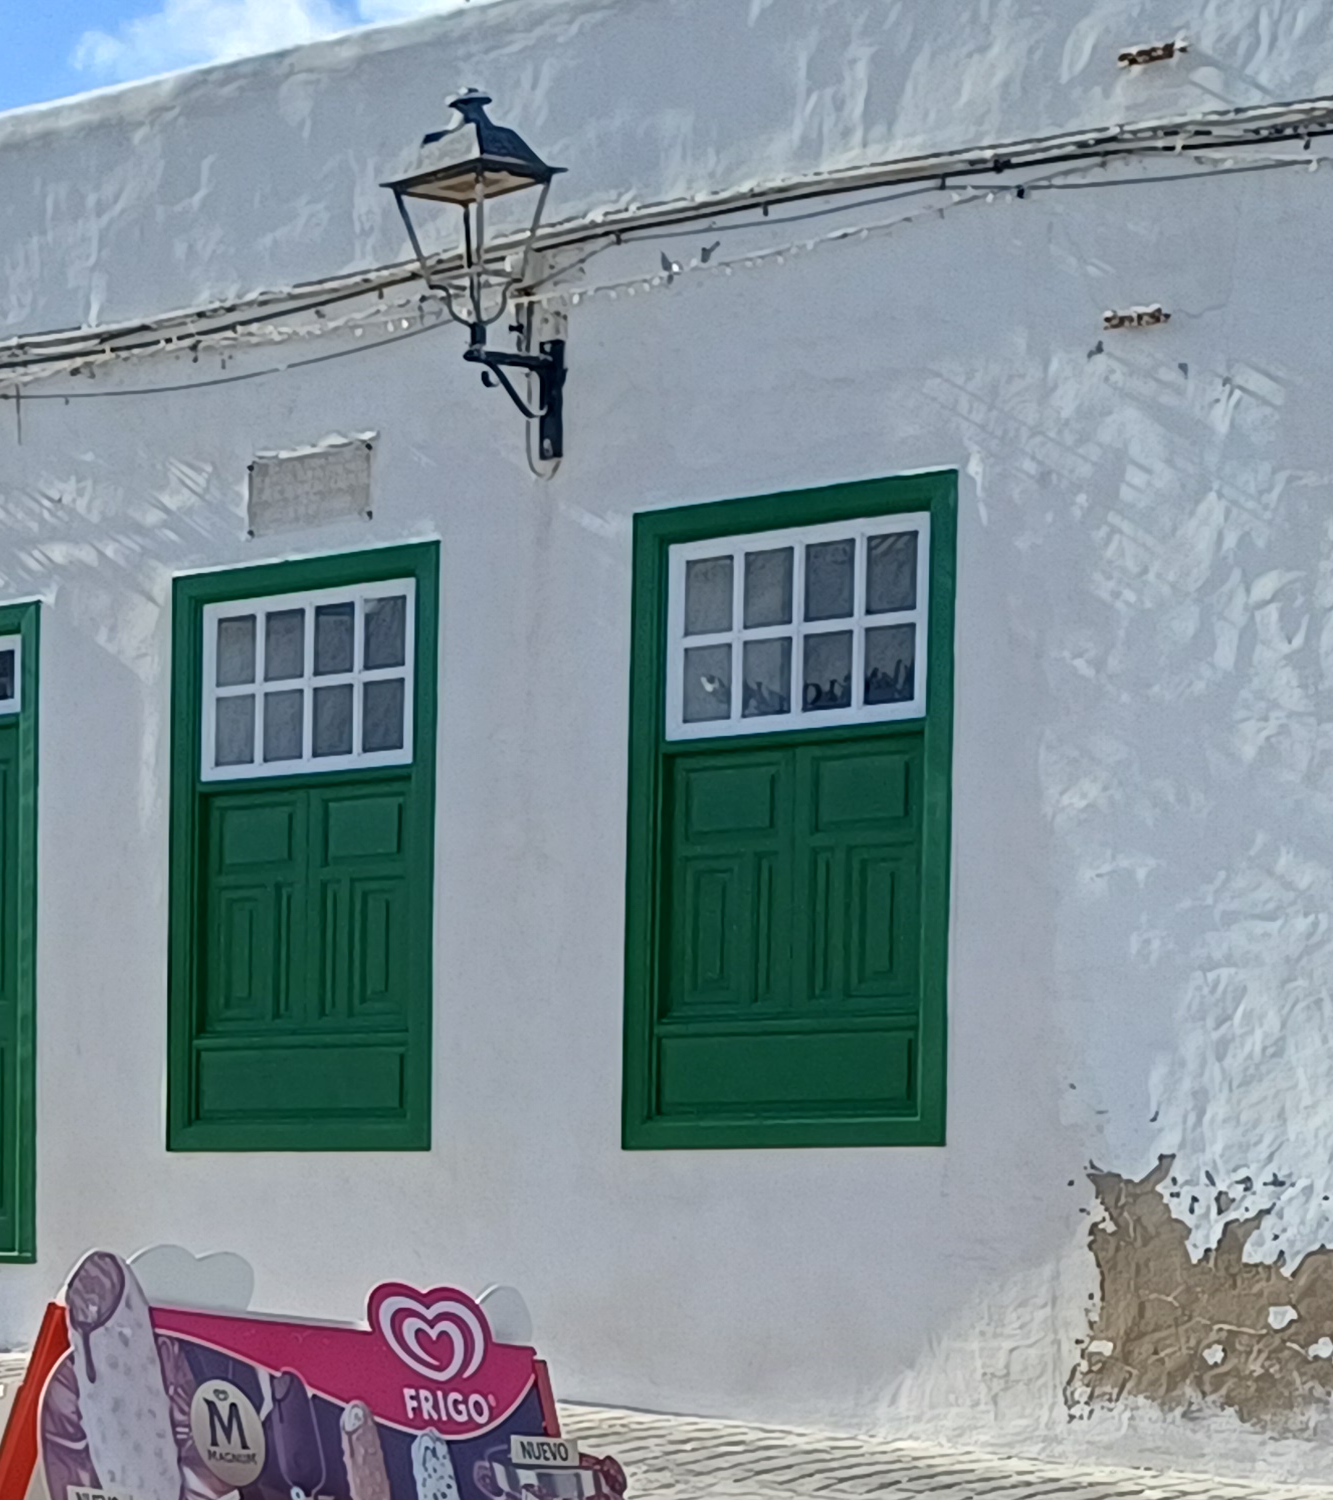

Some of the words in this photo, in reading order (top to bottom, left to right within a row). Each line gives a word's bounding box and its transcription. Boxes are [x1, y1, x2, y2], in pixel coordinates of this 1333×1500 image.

[203, 1397, 250, 1450] M
[403, 1387, 490, 1424] FRIGO
[520, 1440, 569, 1462] NUEVO
